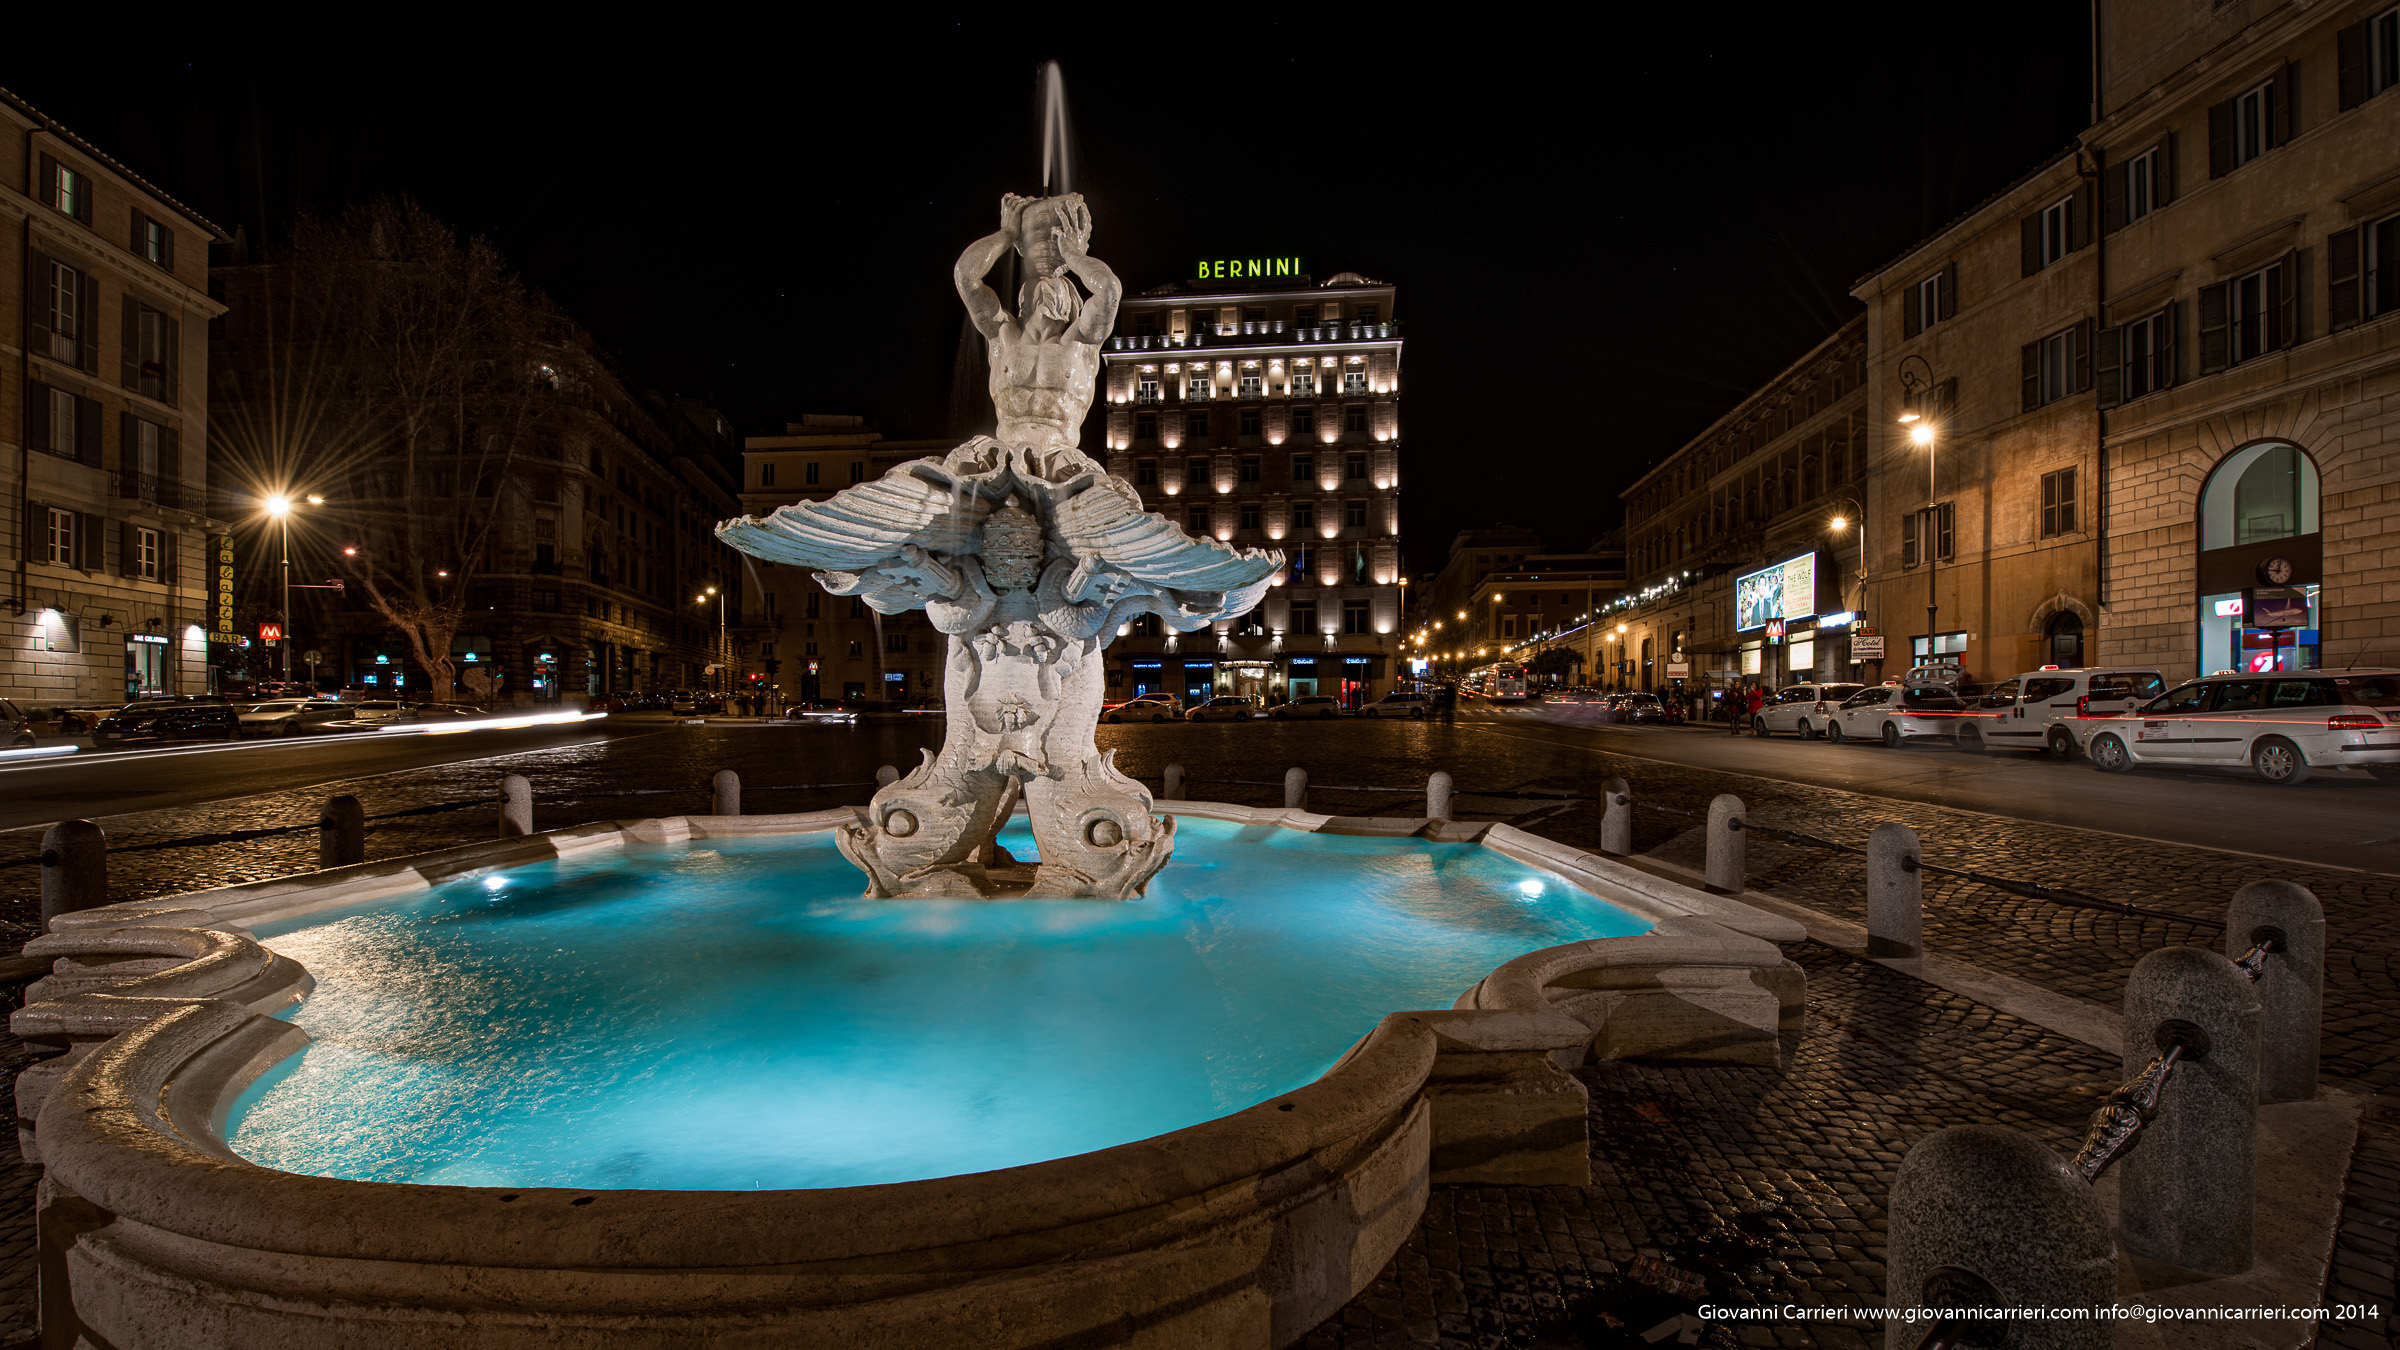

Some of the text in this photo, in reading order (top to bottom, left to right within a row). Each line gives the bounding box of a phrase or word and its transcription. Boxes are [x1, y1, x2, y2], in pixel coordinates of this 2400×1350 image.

[1199, 257, 1299, 279] BERNINI
[261, 625, 280, 636] M
[1767, 621, 1783, 633] M
[213, 633, 239, 643] BAR
